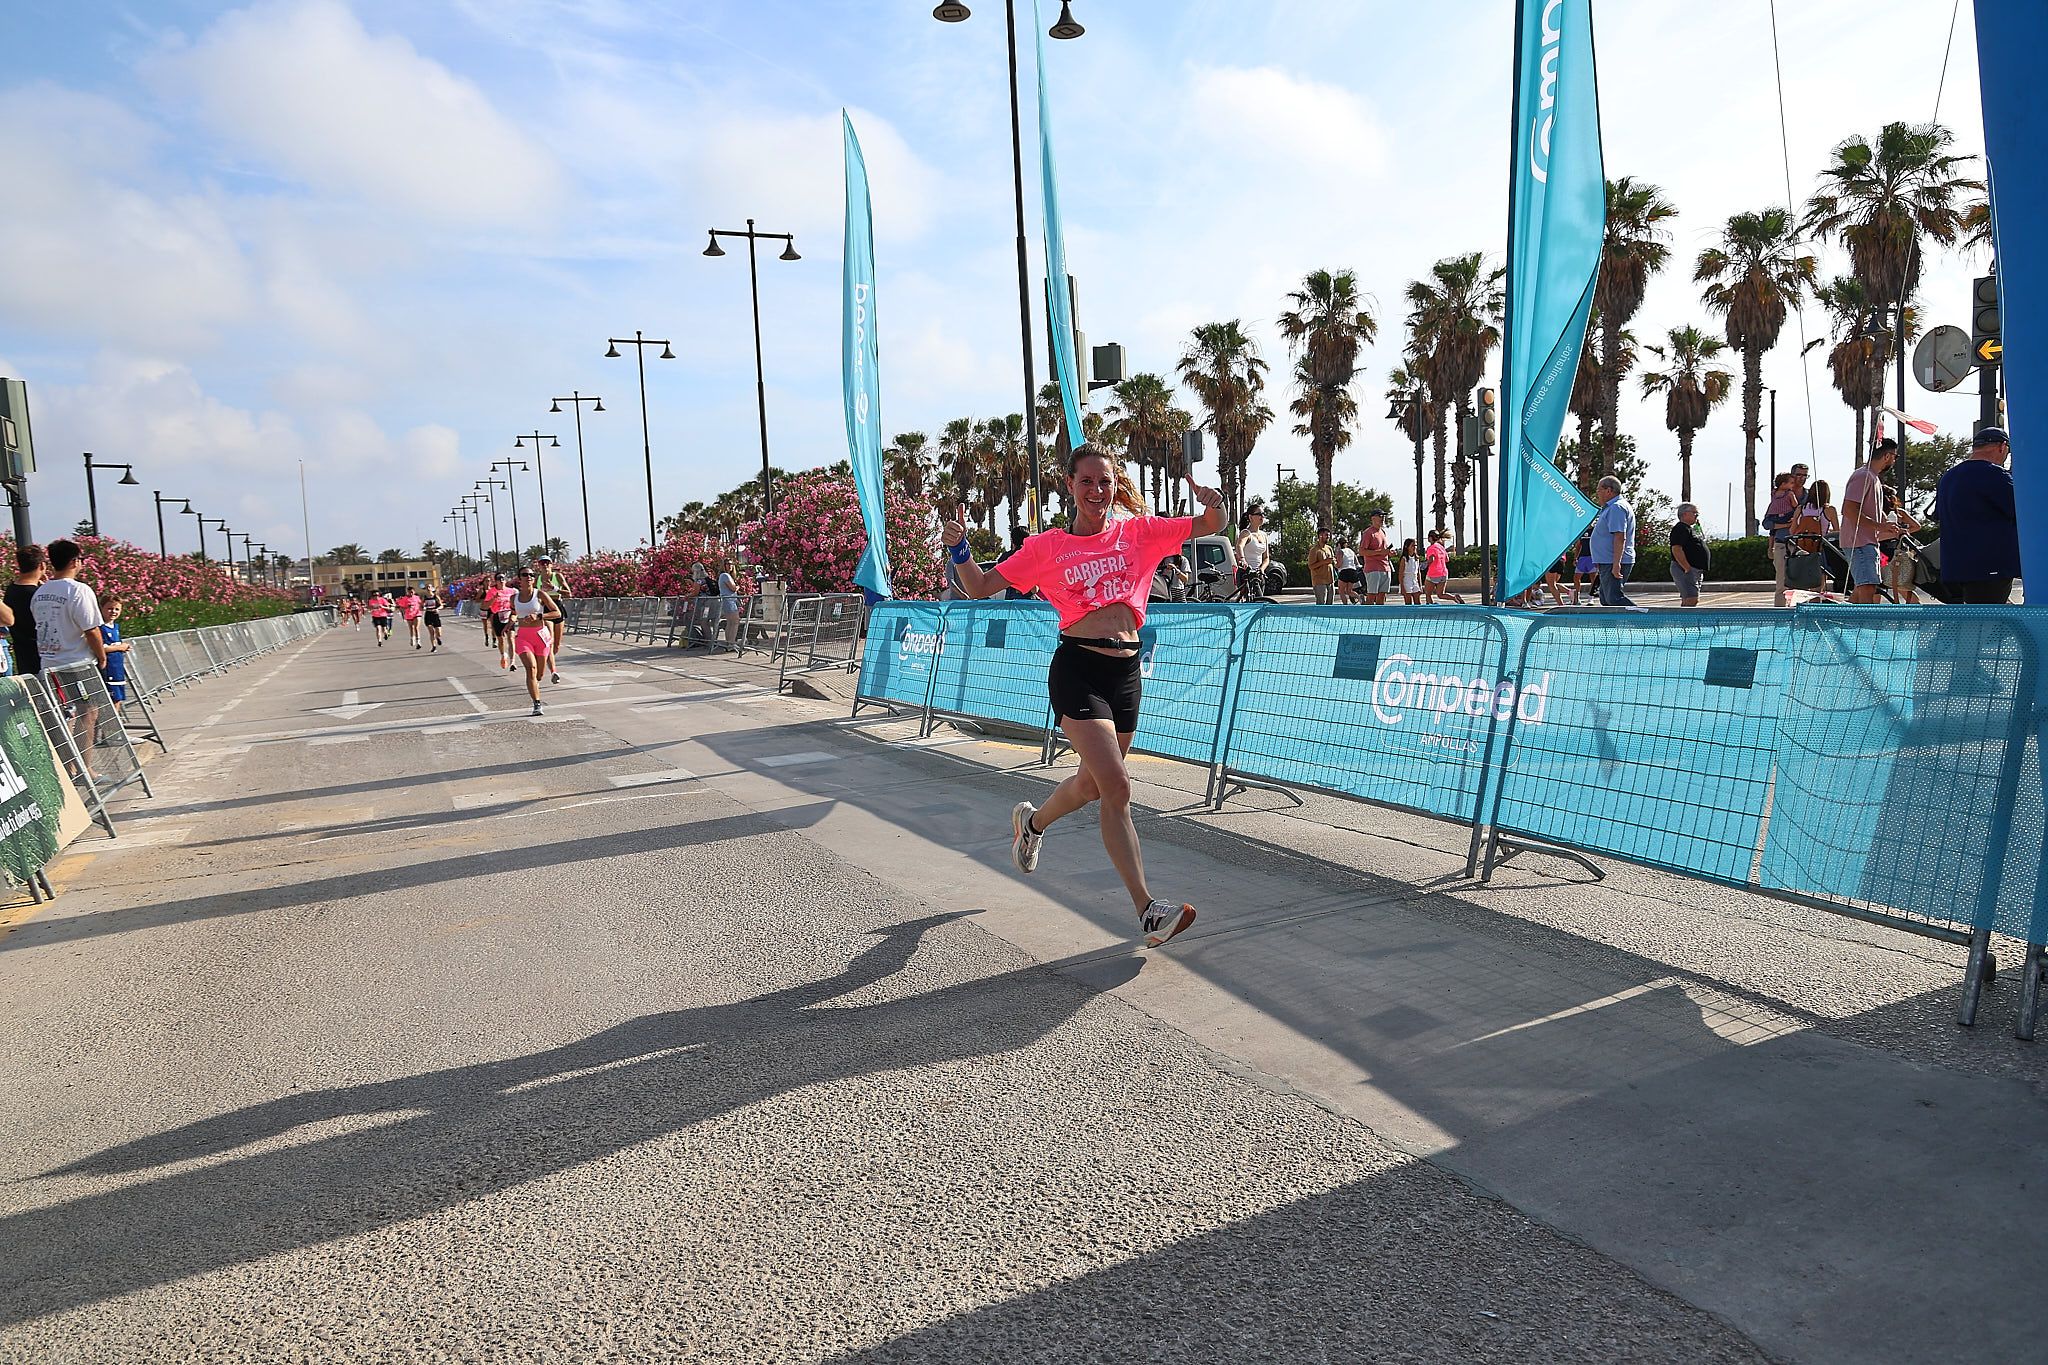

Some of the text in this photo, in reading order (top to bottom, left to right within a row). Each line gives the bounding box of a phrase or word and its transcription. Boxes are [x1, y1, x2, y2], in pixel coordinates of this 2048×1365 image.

[1520, 440, 1586, 518] Cumple con la norma
[1371, 653, 1550, 726] Compeed
[1420, 731, 1479, 753] AMPOLLAS
